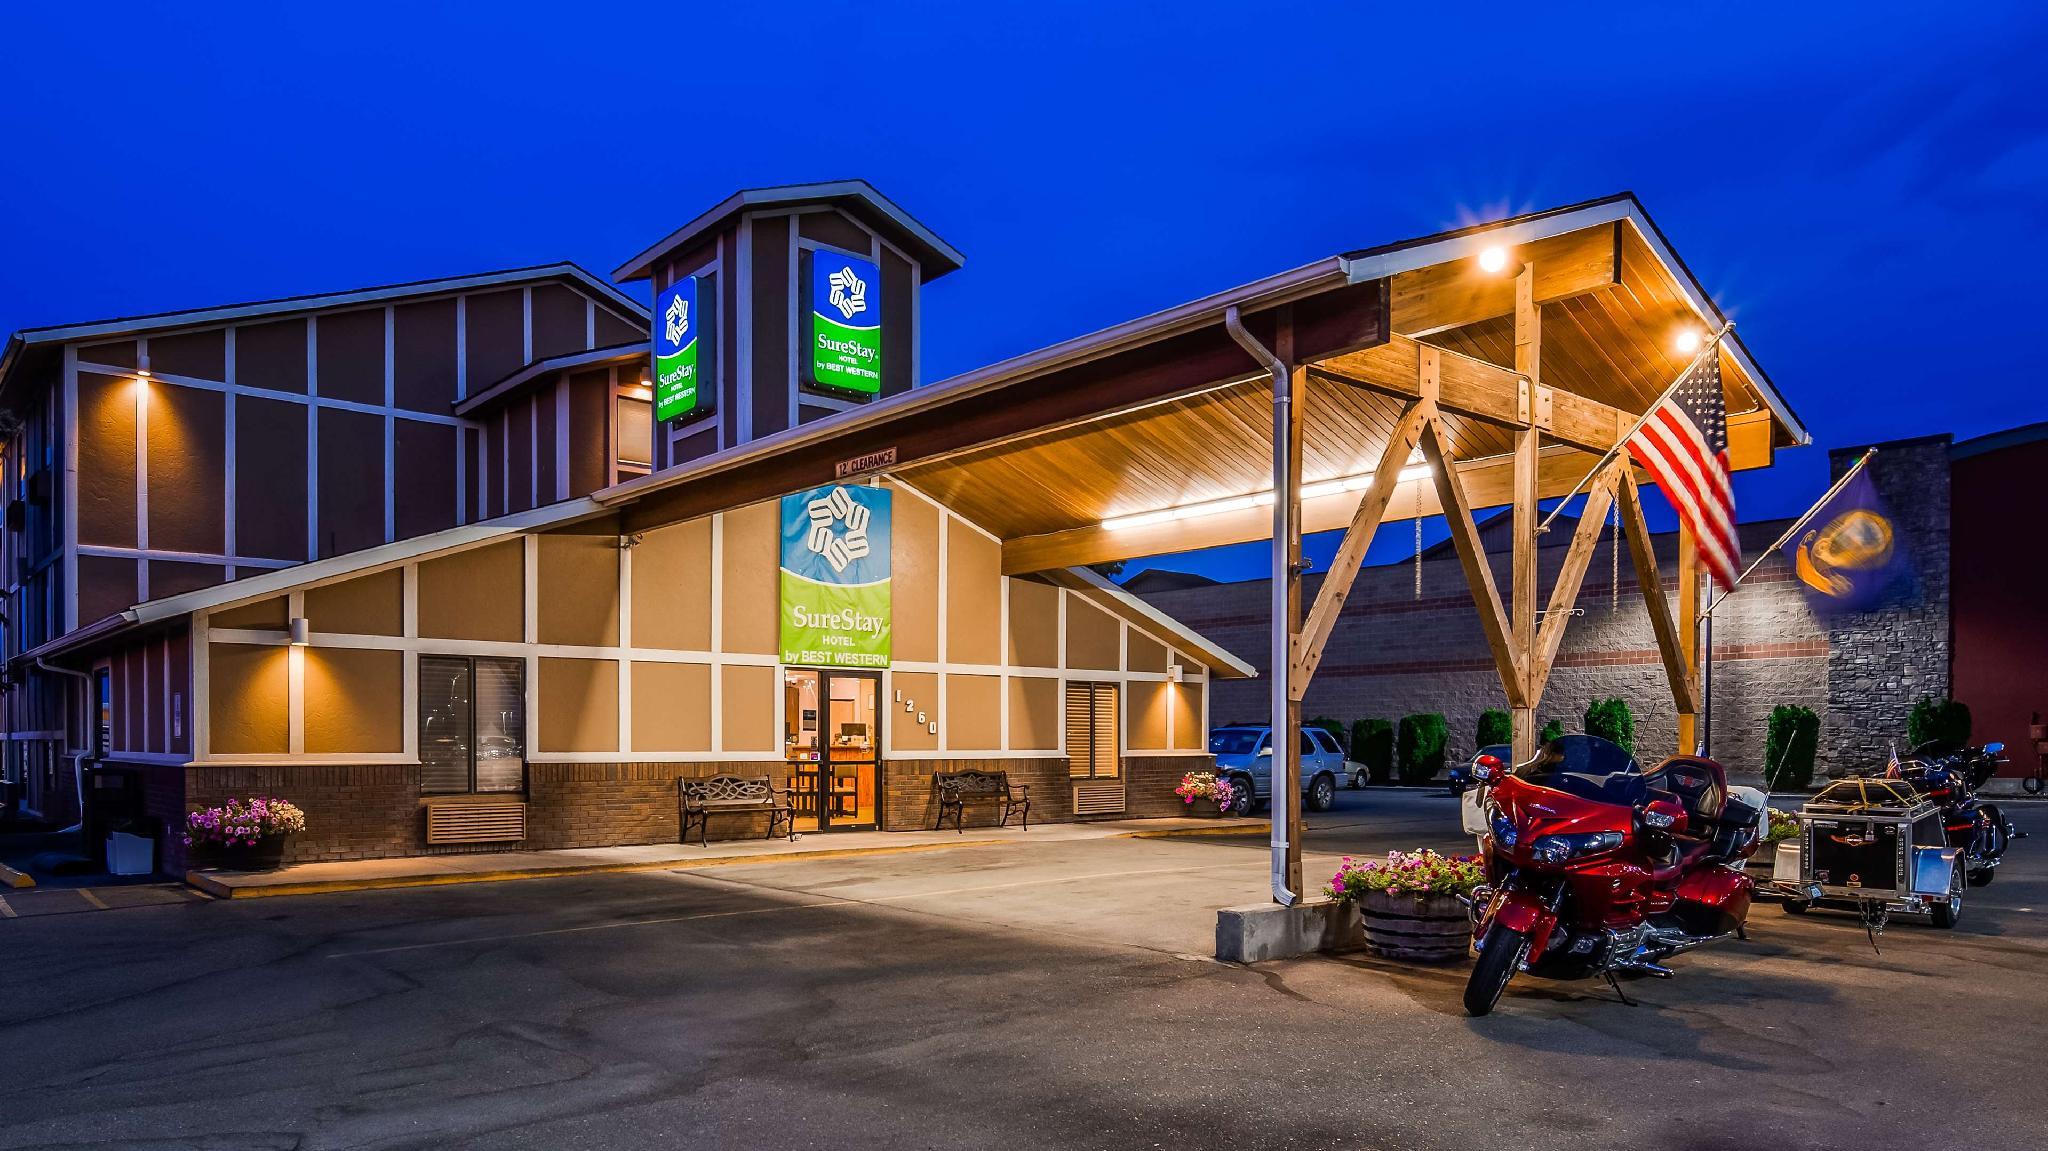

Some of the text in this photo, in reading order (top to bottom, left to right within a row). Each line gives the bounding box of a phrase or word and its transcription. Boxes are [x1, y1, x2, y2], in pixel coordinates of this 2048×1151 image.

[818, 333, 876, 362] SureStay
[816, 360, 879, 379] by BEST WESTERN
[838, 355, 858, 365] HOTEL
[659, 363, 694, 388] SureStay
[851, 450, 893, 472] CLEARANCE
[793, 605, 884, 639] SureStay
[822, 635, 856, 647] HOTEL
[785, 650, 888, 666] by BEST WESTERN
[895, 689, 937, 734] 1260
